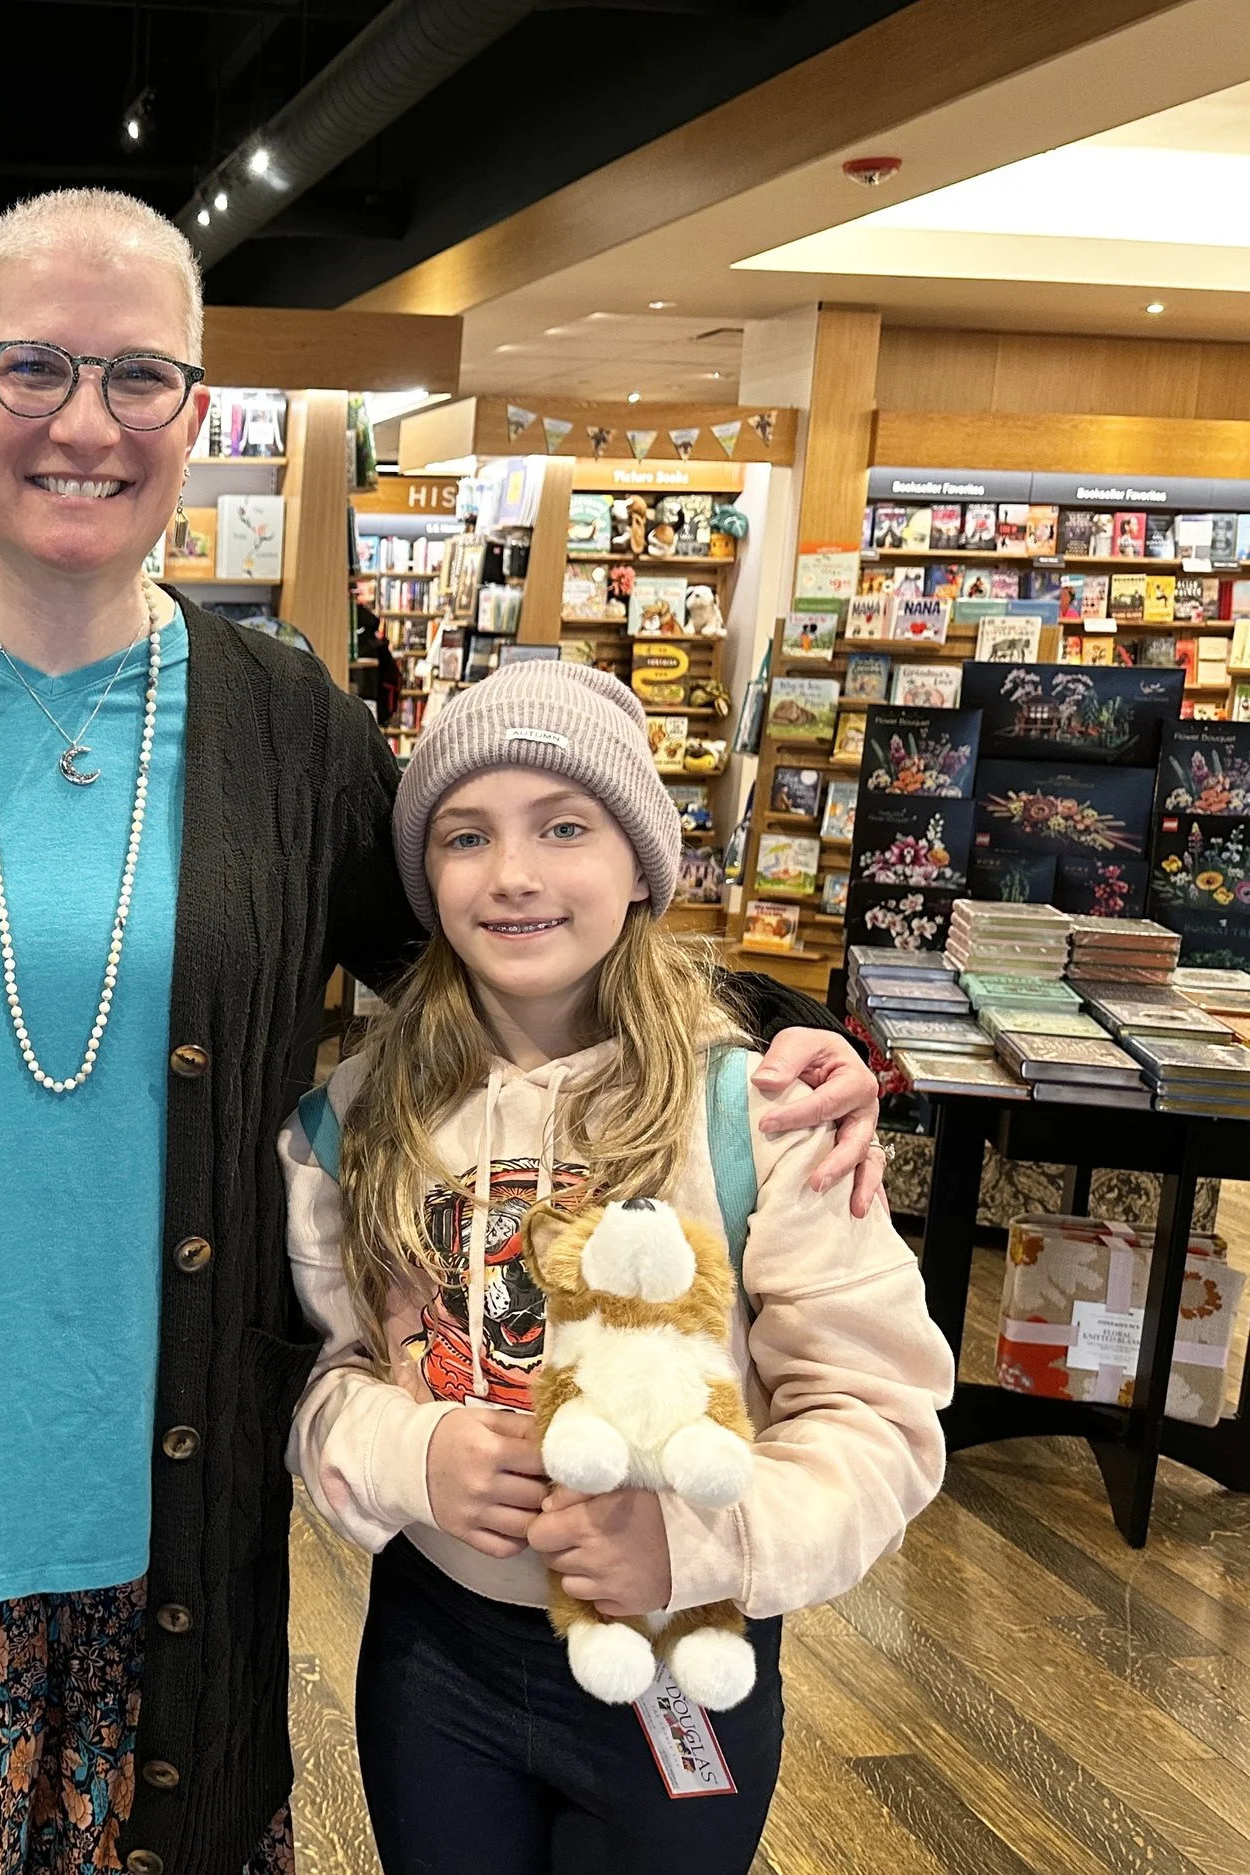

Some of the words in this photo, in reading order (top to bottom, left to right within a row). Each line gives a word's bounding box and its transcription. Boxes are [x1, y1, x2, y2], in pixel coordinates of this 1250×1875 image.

[892, 480, 942, 494] Bookseller
[942, 482, 985, 496] Favorites
[1077, 487, 1125, 501] Bookseller
[1126, 488, 1167, 502] Favorites
[408, 485, 457, 508] HIS
[904, 601, 941, 616] NANA
[512, 729, 561, 743] AUTUMN
[666, 1685, 716, 1784] DOUGLAS
